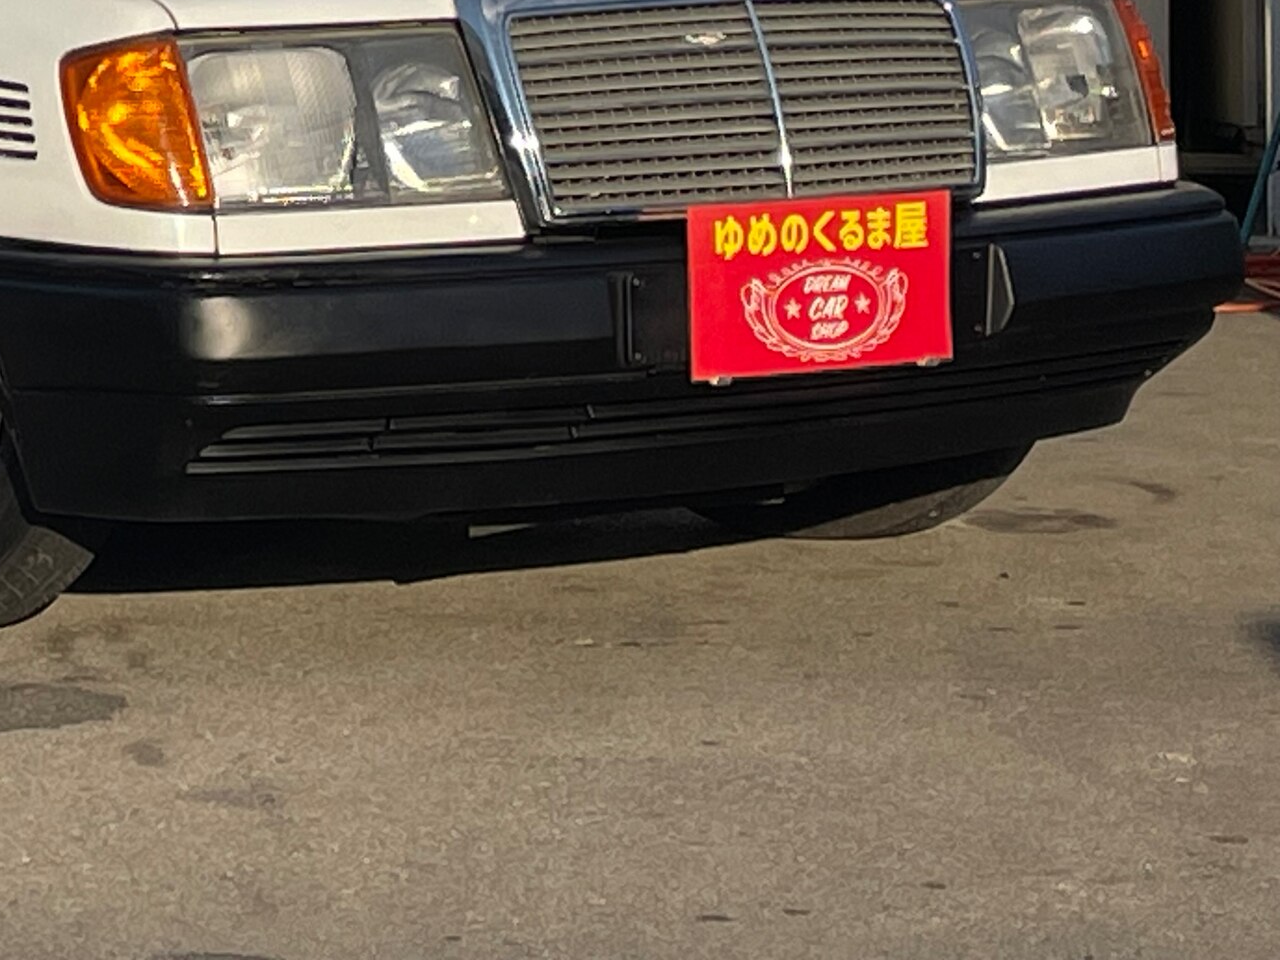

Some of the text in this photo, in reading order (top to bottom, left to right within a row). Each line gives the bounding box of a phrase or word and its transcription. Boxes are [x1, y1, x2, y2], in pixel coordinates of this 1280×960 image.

[714, 201, 929, 260] ゆめのくるま屋
[803, 274, 852, 294] DREAM
[808, 294, 849, 321] CAR
